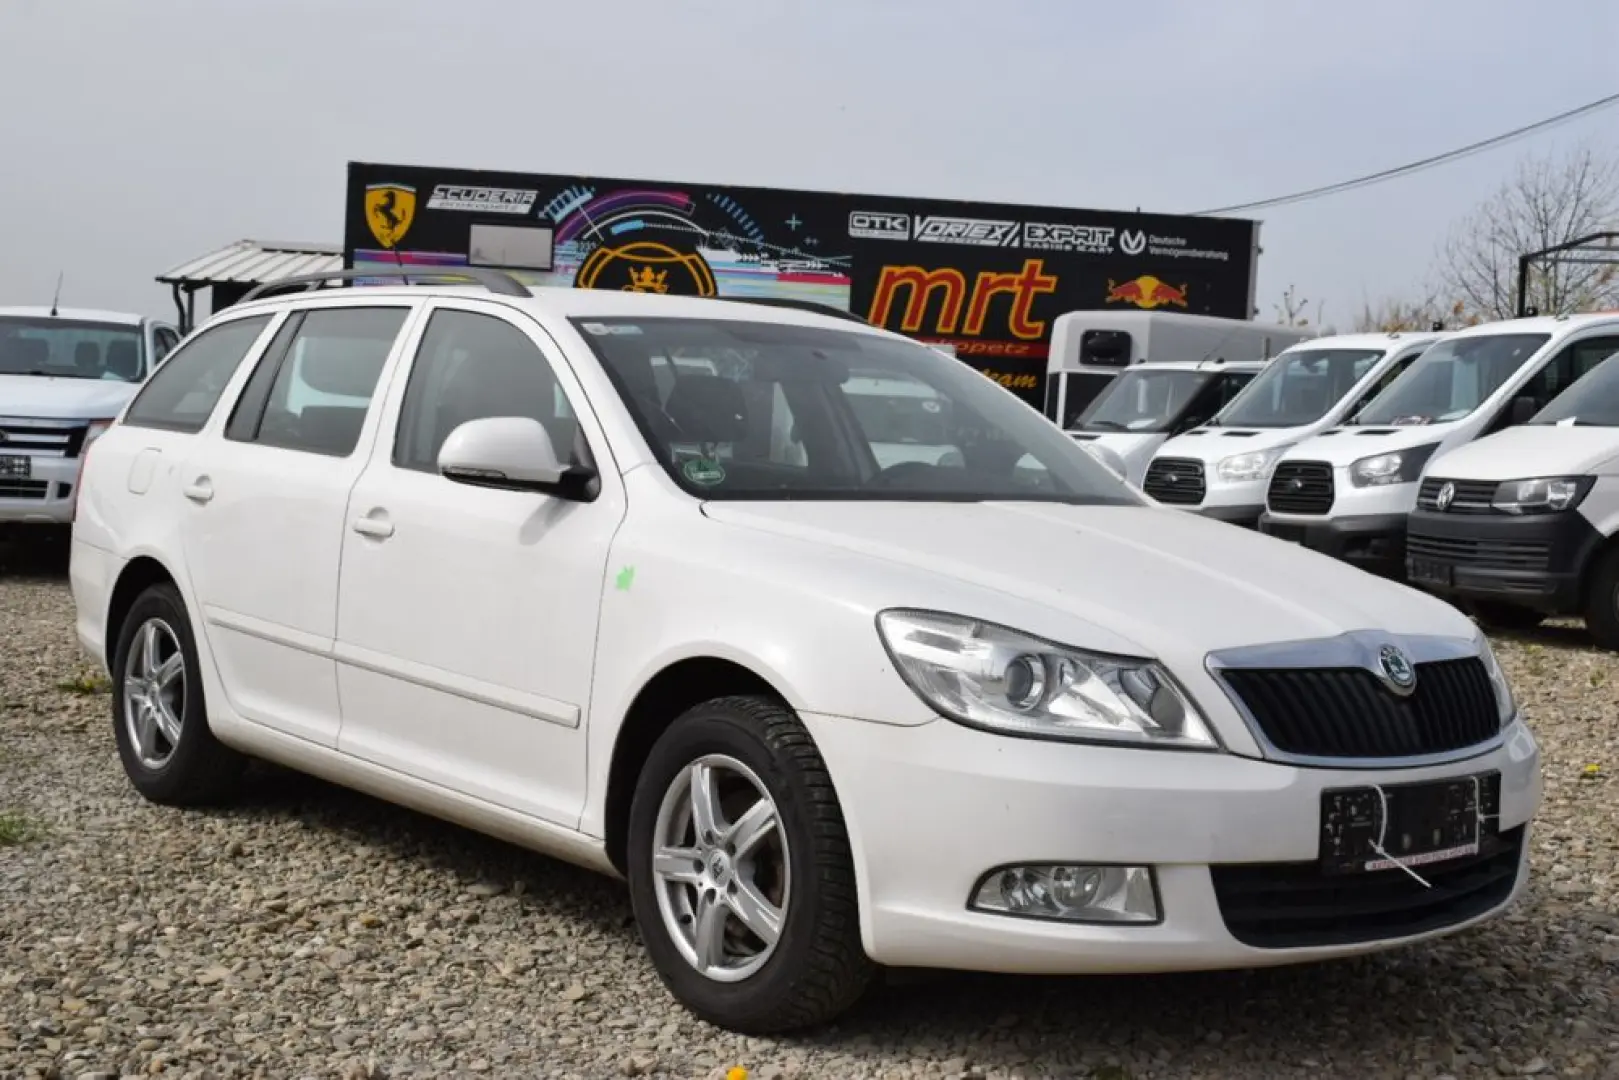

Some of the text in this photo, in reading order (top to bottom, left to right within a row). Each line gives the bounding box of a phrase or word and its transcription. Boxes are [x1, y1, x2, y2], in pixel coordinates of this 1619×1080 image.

[852, 215, 905, 230] OTK
[914, 215, 1014, 245] VORTEX
[1024, 221, 1115, 246] EXPRIT
[1149, 234, 1187, 246] Deutsche
[868, 259, 1058, 339] mrt
